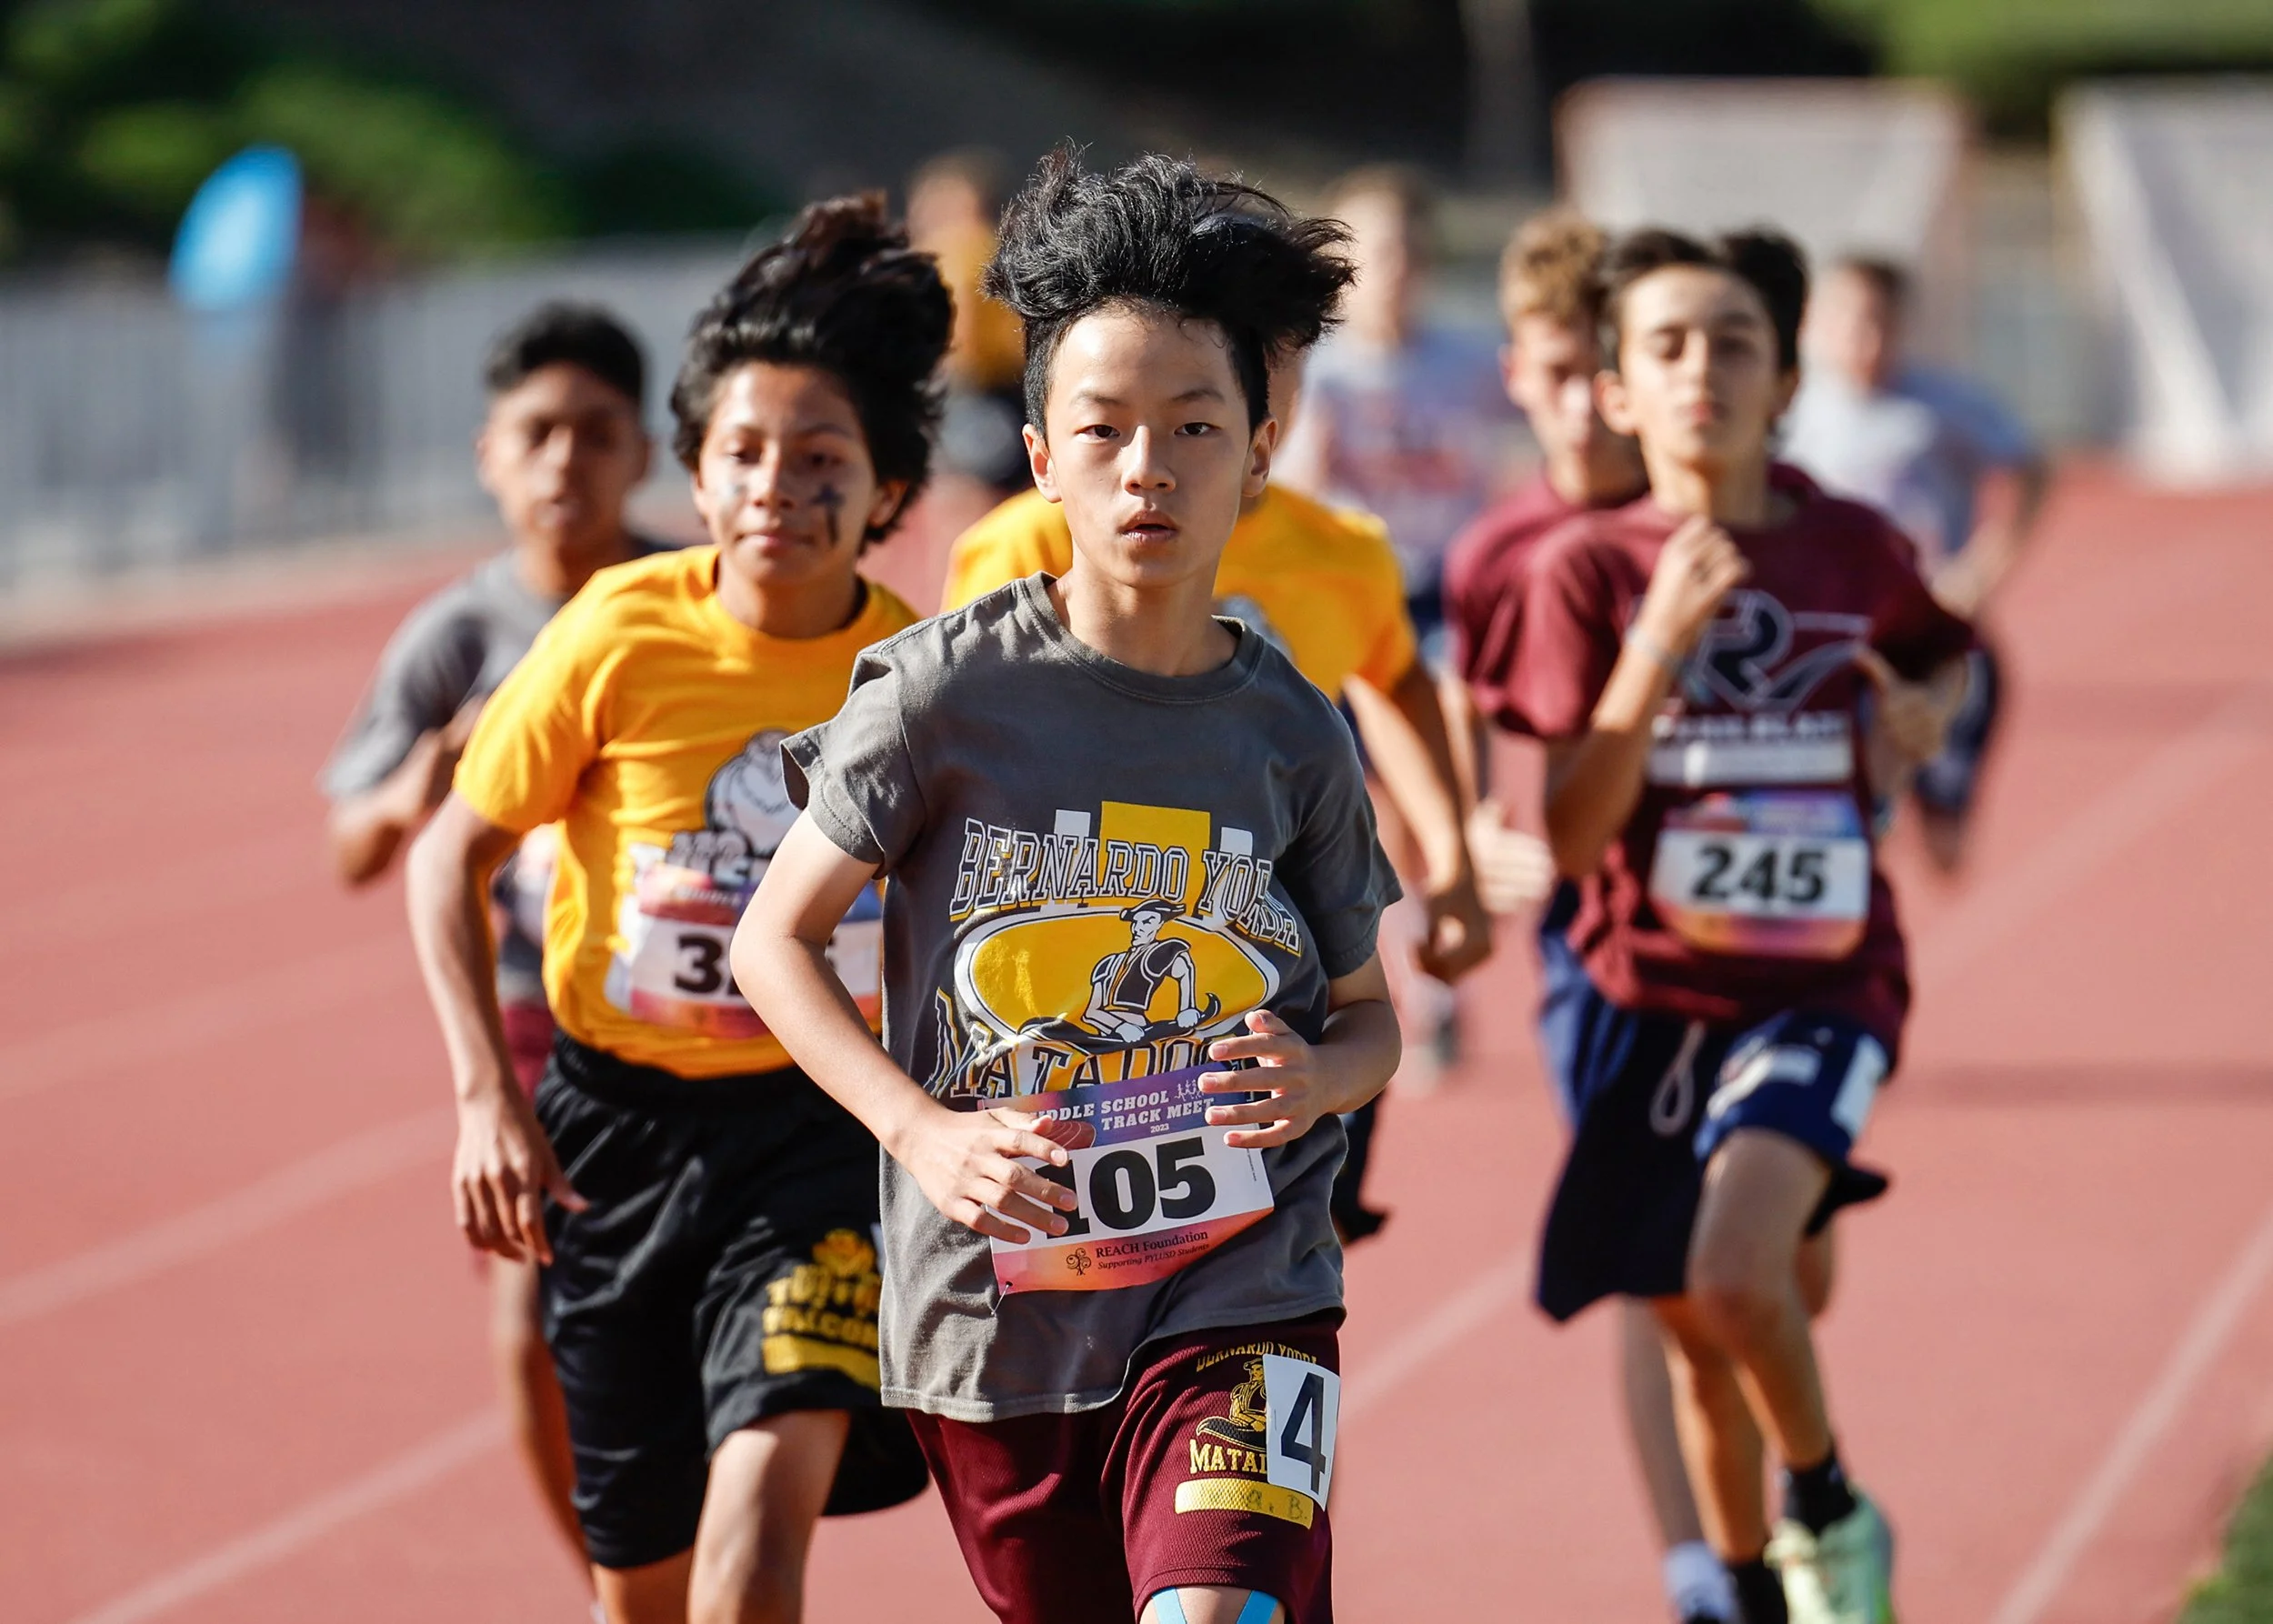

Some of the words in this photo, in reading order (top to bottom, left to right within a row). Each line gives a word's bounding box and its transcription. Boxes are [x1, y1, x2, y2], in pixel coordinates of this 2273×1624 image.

[949, 817, 1190, 920] BERNARDO
[1691, 846, 1827, 902] 245
[924, 987, 1250, 1100] MATADO
[1034, 1102, 1095, 1122] DDLE
[1101, 1090, 1169, 1115] SCHOOL
[1101, 1109, 1161, 1131] TRACK
[1167, 1098, 1215, 1120] MEET
[1150, 1124, 1170, 1134] 2023
[1035, 1136, 1217, 1239] 105
[1096, 1242, 1139, 1258] REACH
[1143, 1231, 1208, 1252] Foundation
[1097, 1258, 1143, 1270] Supporting
[1177, 1243, 1210, 1256] Students
[1280, 1371, 1327, 1496] 4
